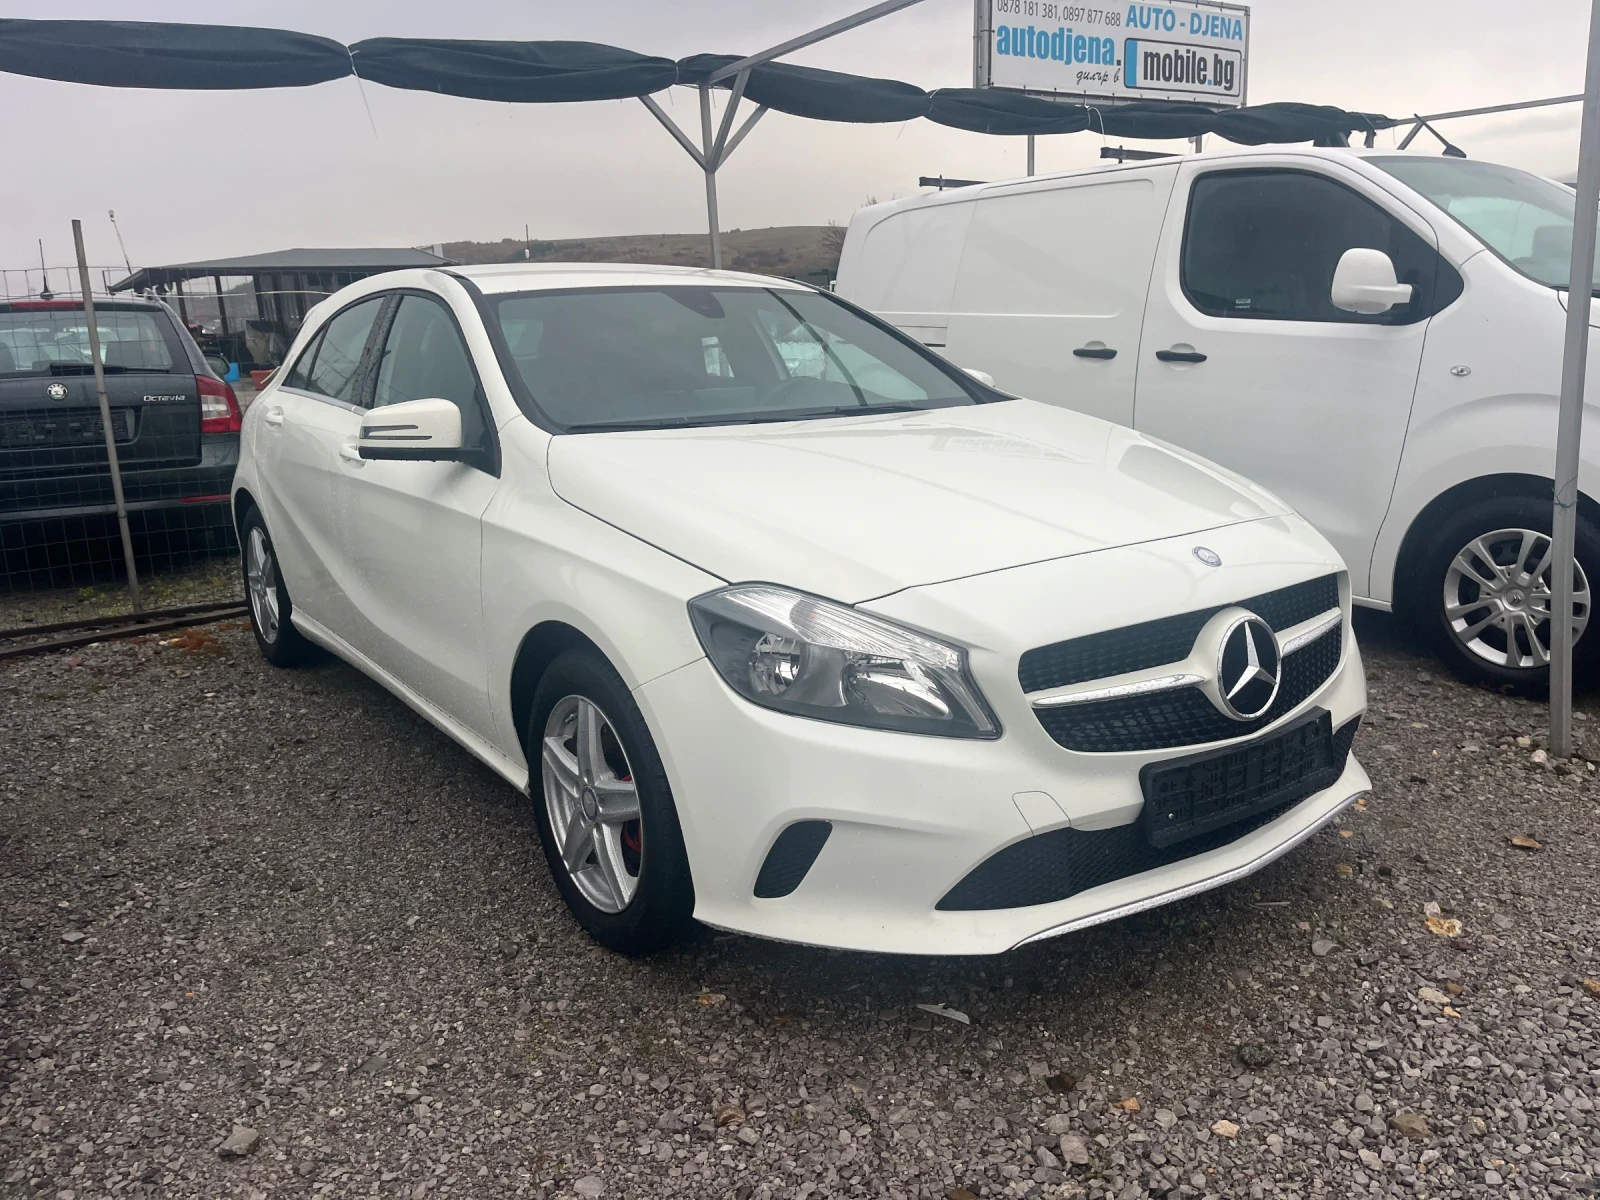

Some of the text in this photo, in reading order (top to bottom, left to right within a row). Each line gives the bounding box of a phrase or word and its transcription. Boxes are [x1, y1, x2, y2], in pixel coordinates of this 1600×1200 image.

[997, 0, 1121, 27] 0878 181 381, 0897 877 688
[1125, 5, 1176, 32] AUTO
[1189, 12, 1243, 41] DJENA
[996, 25, 1121, 66] autodjena.
[1143, 49, 1235, 91] mobile.bg
